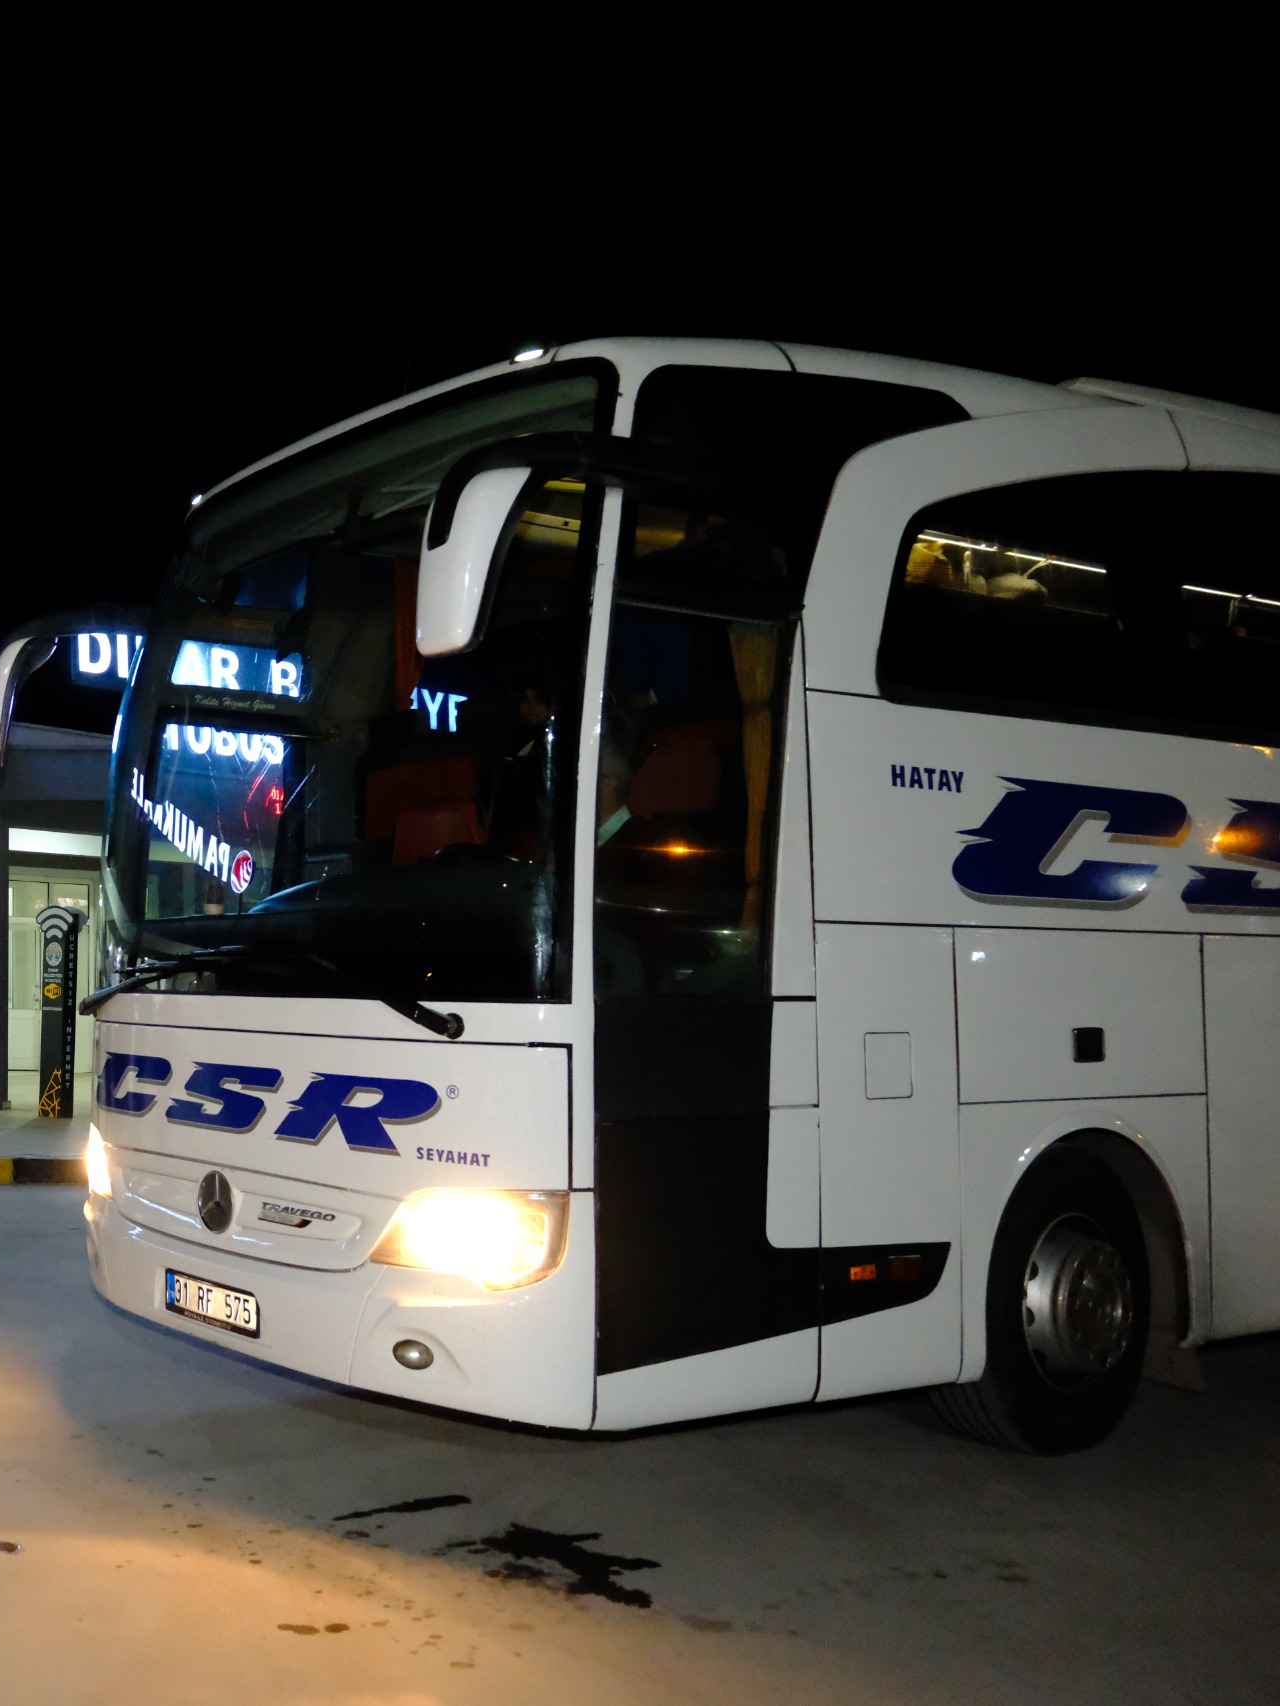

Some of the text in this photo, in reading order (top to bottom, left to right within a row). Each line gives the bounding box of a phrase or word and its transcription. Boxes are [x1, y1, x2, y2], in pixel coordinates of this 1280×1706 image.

[891, 764, 964, 793] HATAY
[97, 1051, 442, 1155] CSR
[416, 1146, 491, 1168] SEYAHAT
[262, 1202, 336, 1221] TRAVEGO
[175, 1280, 251, 1324] 31 RF 575
